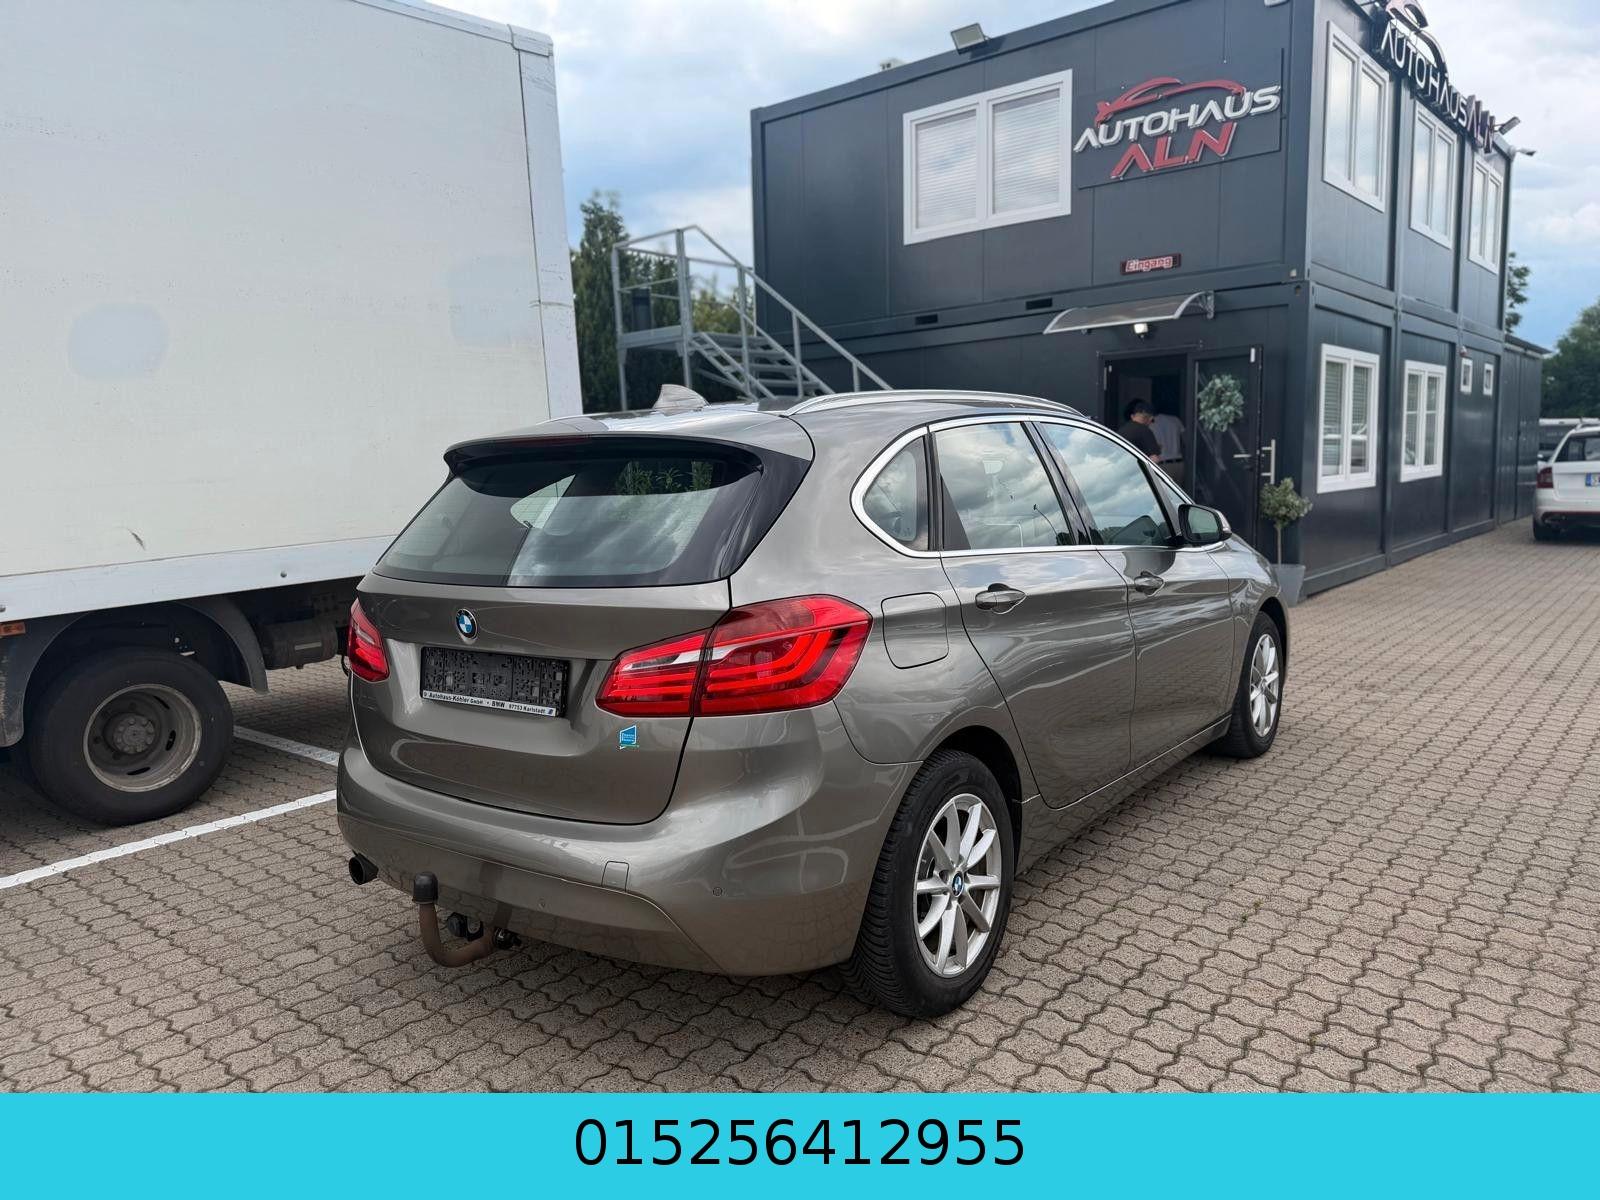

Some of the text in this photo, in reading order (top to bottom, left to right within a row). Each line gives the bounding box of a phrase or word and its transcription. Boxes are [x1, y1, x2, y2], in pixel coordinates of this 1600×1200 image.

[1381, 20, 1468, 128] AUTOHAUS
[1074, 85, 1281, 153] AUTOHAUS
[1110, 121, 1237, 179] ALN
[1124, 256, 1174, 273] Eingang
[491, 700, 506, 708] BMW
